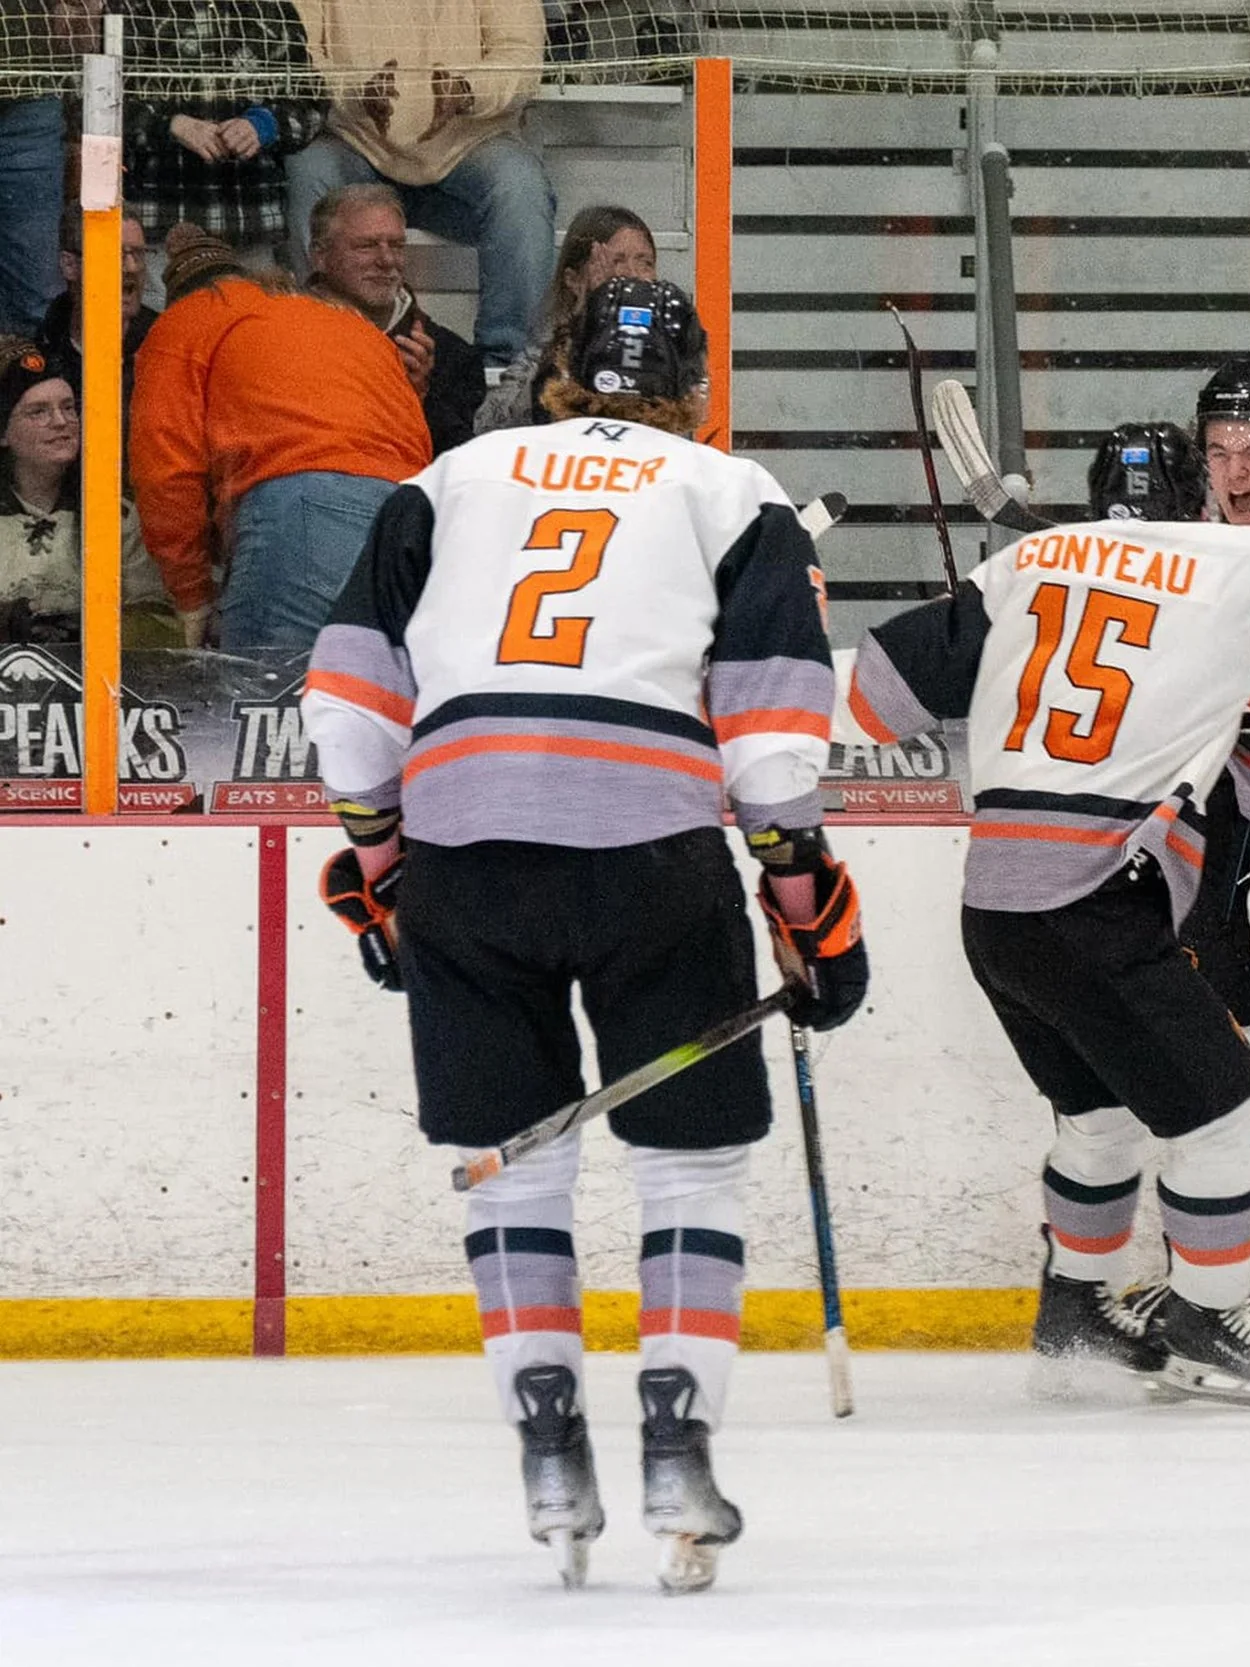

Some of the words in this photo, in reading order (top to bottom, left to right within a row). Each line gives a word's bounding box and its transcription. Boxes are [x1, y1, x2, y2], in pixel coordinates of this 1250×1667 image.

[511, 446, 666, 493] LUGER
[496, 508, 619, 668] 2
[1015, 534, 1198, 596] GONYEAU
[1003, 581, 1160, 765] 15
[240, 707, 310, 777] TW
[6, 786, 77, 801] SCENIC
[119, 792, 184, 805] VIEWS
[227, 790, 276, 804] EATS
[881, 789, 948, 803] VIEWS
